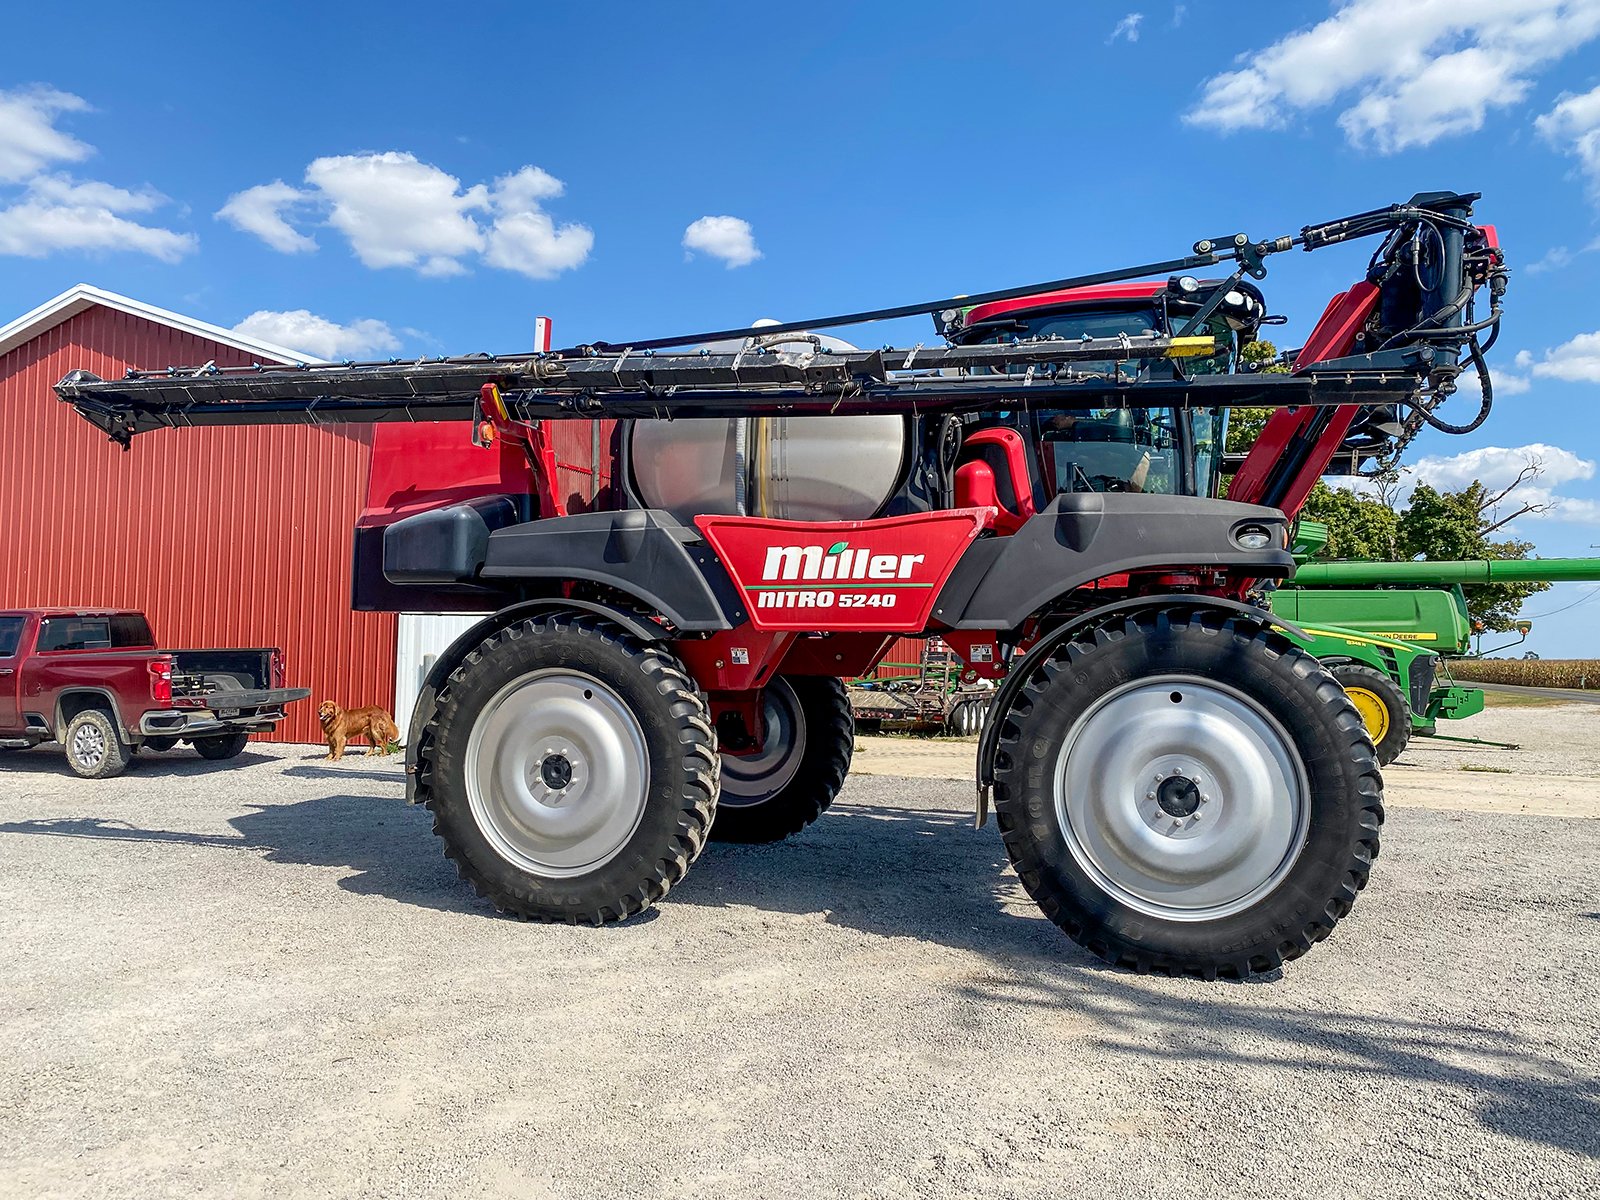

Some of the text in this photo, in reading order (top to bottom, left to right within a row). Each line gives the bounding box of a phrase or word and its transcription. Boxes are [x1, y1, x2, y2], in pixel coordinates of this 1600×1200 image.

[762, 542, 926, 581] Miller
[757, 591, 896, 608] NITRO 5240
